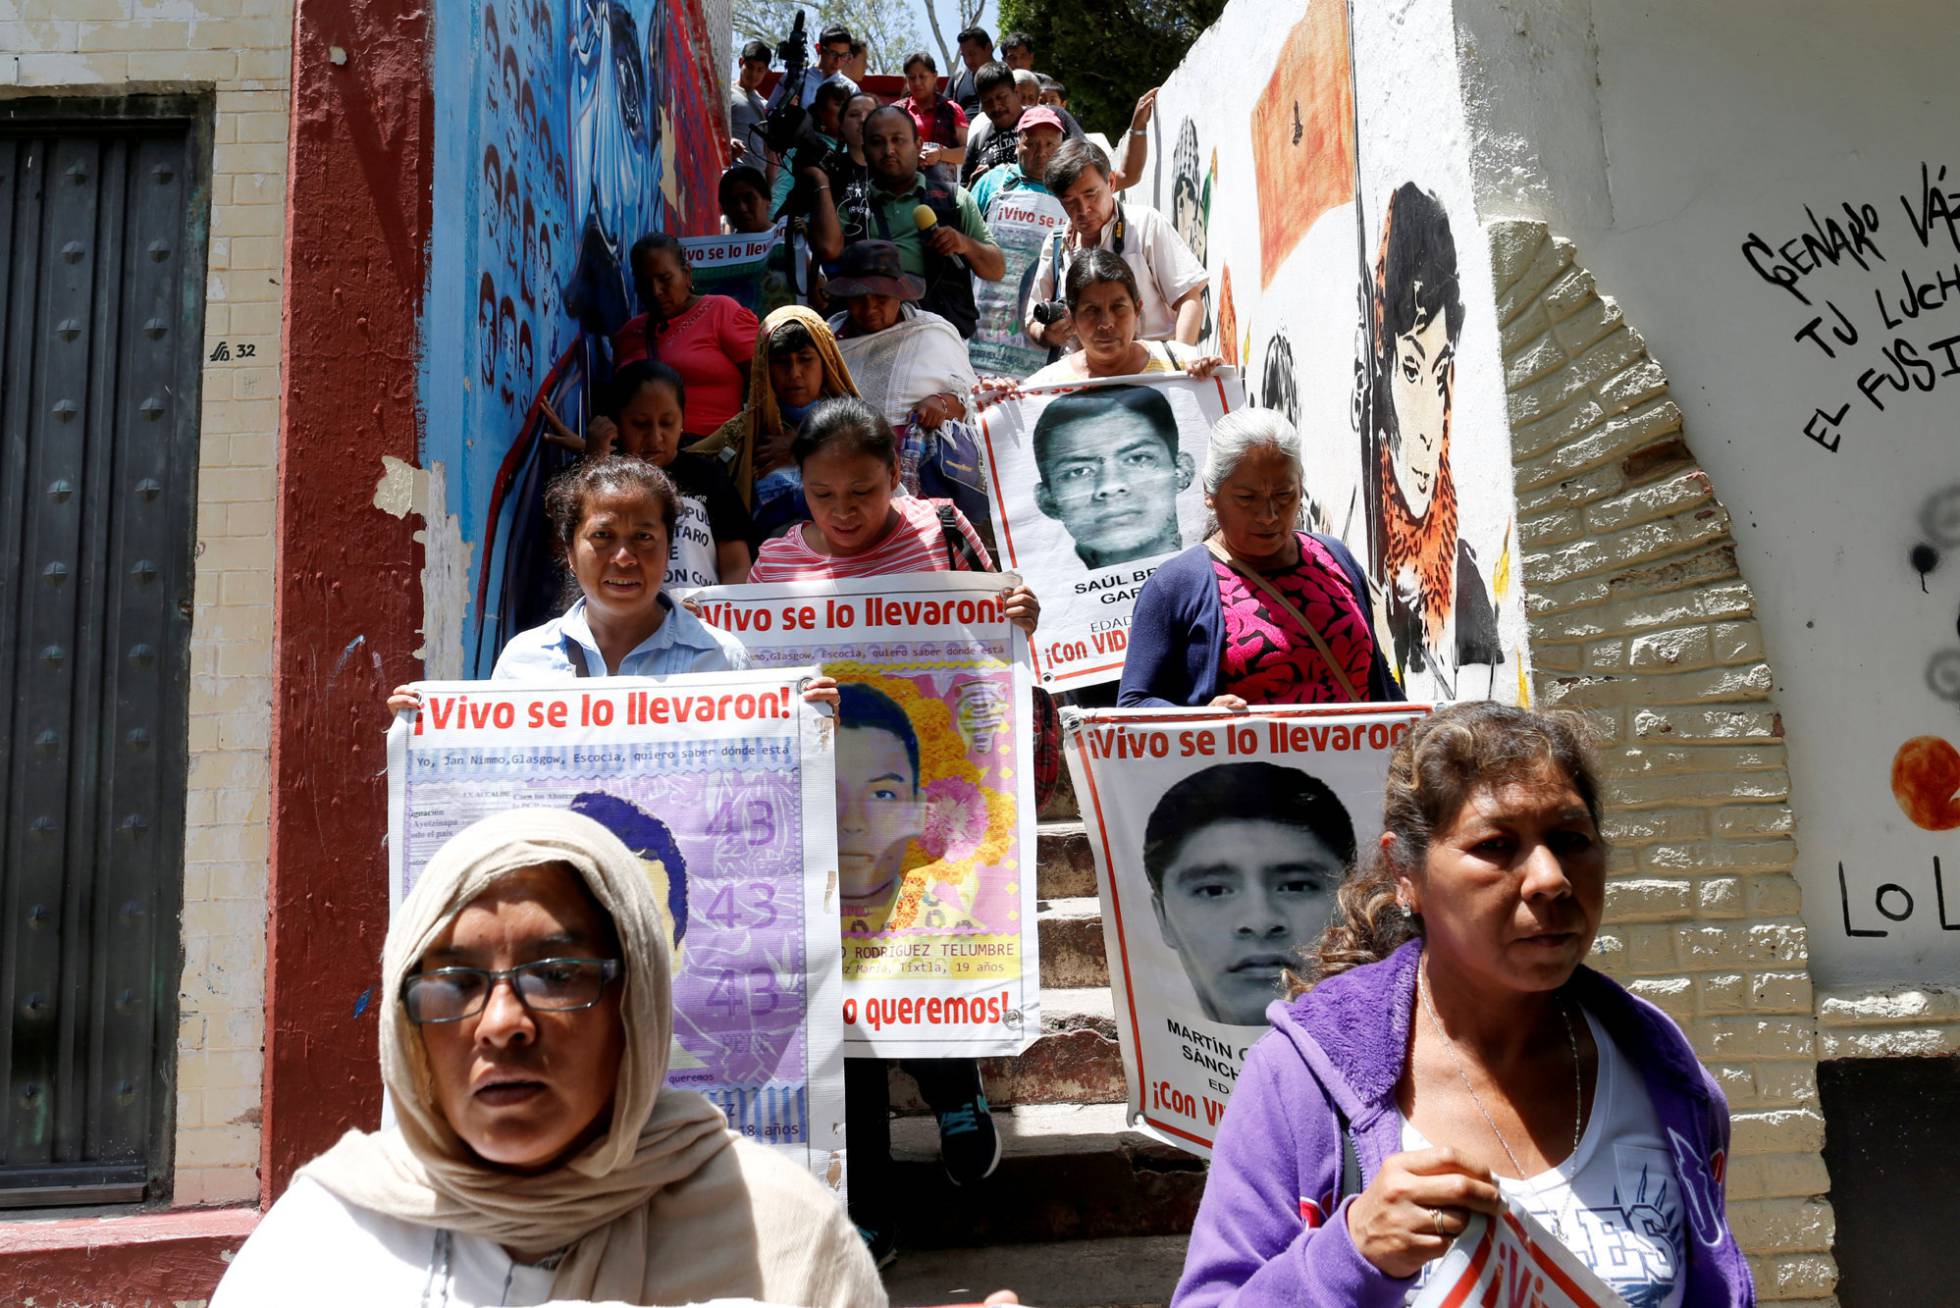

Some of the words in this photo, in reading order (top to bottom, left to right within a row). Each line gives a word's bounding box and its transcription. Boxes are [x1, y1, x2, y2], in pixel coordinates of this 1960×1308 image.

[998, 207, 1035, 223] ¡Vivo
[1039, 215, 1055, 227] se
[682, 247, 704, 260] ivo
[708, 247, 724, 259] se
[729, 245, 742, 258] lo
[1795, 300, 1858, 358] TU
[236, 343, 256, 358] 32
[1803, 403, 1850, 453] EL
[1075, 574, 1128, 594] SAÚL
[699, 602, 771, 632] Vivo
[782, 604, 816, 631] se
[827, 600, 854, 628] lo
[865, 596, 1005, 626] llevaron!
[913, 647, 940, 656] saber
[1045, 640, 1088, 669] ¡Con
[1091, 627, 1132, 655] VID
[414, 695, 515, 735] ¡Vivo
[528, 701, 568, 728] se
[581, 694, 614, 727] lo
[627, 686, 790, 725] llevaron!
[634, 750, 675, 763] quiero
[1087, 726, 1169, 760] ¡Vivo
[1180, 729, 1215, 757] se
[1227, 724, 1258, 755] lo
[705, 800, 776, 846] 43
[705, 883, 778, 929] 43
[940, 943, 1014, 957] TELUMBRE
[956, 963, 970, 972] 19
[977, 961, 1005, 972] años
[706, 967, 779, 1017] 43
[866, 991, 1009, 1031] queremos!
[1167, 1019, 1232, 1060] MARTÍN
[668, 1072, 714, 1084] queremos
[1153, 1081, 1196, 1119] ¡Con
[764, 1122, 799, 1137] años
